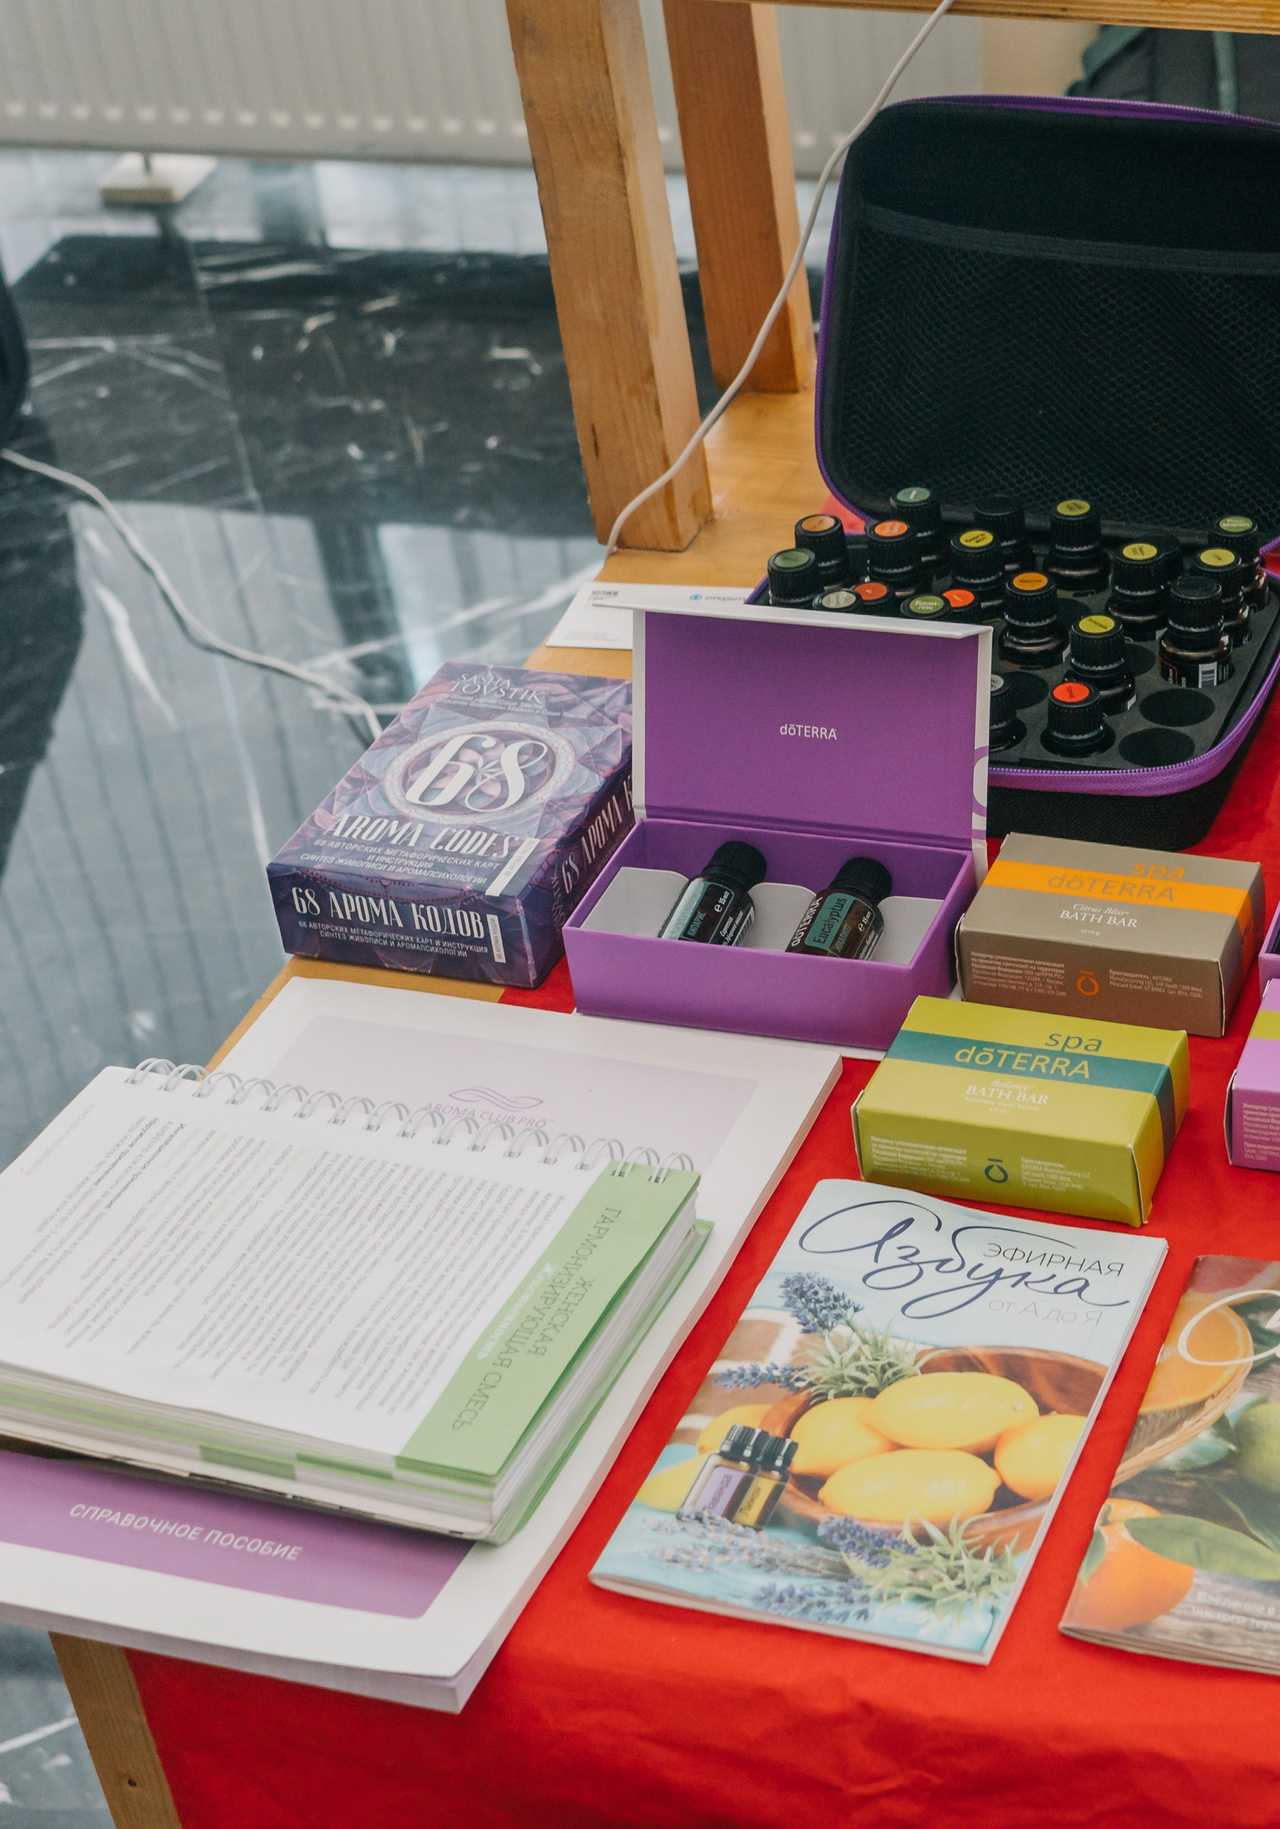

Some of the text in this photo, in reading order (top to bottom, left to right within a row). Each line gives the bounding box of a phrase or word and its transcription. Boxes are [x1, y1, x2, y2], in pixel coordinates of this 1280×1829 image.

[404, 732, 549, 814] 68
[326, 813, 425, 847] AROMA
[430, 827, 520, 859] CODES
[300, 853, 335, 864] СИНТЕЗ
[336, 858, 387, 871] ЖИВОПИСИ
[396, 865, 488, 885] АРОМАПСИХОЛОГИИ
[328, 840, 384, 854] АВТОРСКИХ
[384, 847, 473, 866] МЕТАФОРИЧЕСКИХ
[474, 860, 501, 870] КАРТ
[376, 856, 434, 869] ИНСТРУКЦИЯ
[1129, 862, 1185, 880] spa
[561, 851, 580, 894] 68
[1047, 874, 1175, 901] dōTERRA
[291, 886, 485, 939] 68 АРОМА КОДОВ
[823, 896, 848, 946] Eucalyptus
[1060, 910, 1138, 928] BATH BAR
[1073, 903, 1102, 913] Citrus
[308, 922, 349, 934] АВТОРСКИХ
[350, 927, 415, 943] МЕТАФОРИЧЕСКИХ
[416, 936, 434, 945] КАРТ
[320, 930, 347, 941] СИНТЕЗ
[348, 933, 389, 946] ЖИВОПИСИ
[397, 940, 468, 957] АРОМАПСИХОЛОГИИ
[1044, 1032, 1103, 1052] spa
[954, 1045, 1091, 1079] dōTERRA
[965, 1084, 1013, 1101] BATH
[1016, 1091, 1049, 1106] BAR
[426, 1103, 476, 1118] AROMA
[480, 1111, 515, 1123] CLUB
[799, 1199, 1131, 1320] Азбука
[981, 1242, 1125, 1278] ЭФИРНАЯ
[451, 1205, 623, 1432] ГАРМОНИЗИРУЮЩАЯ СМЕСЬ
[527, 1277, 597, 1359] ЖЕНСКАЯ
[68, 1503, 303, 1562] СПРАВОЧНОЕ ПОСОБИЕ
